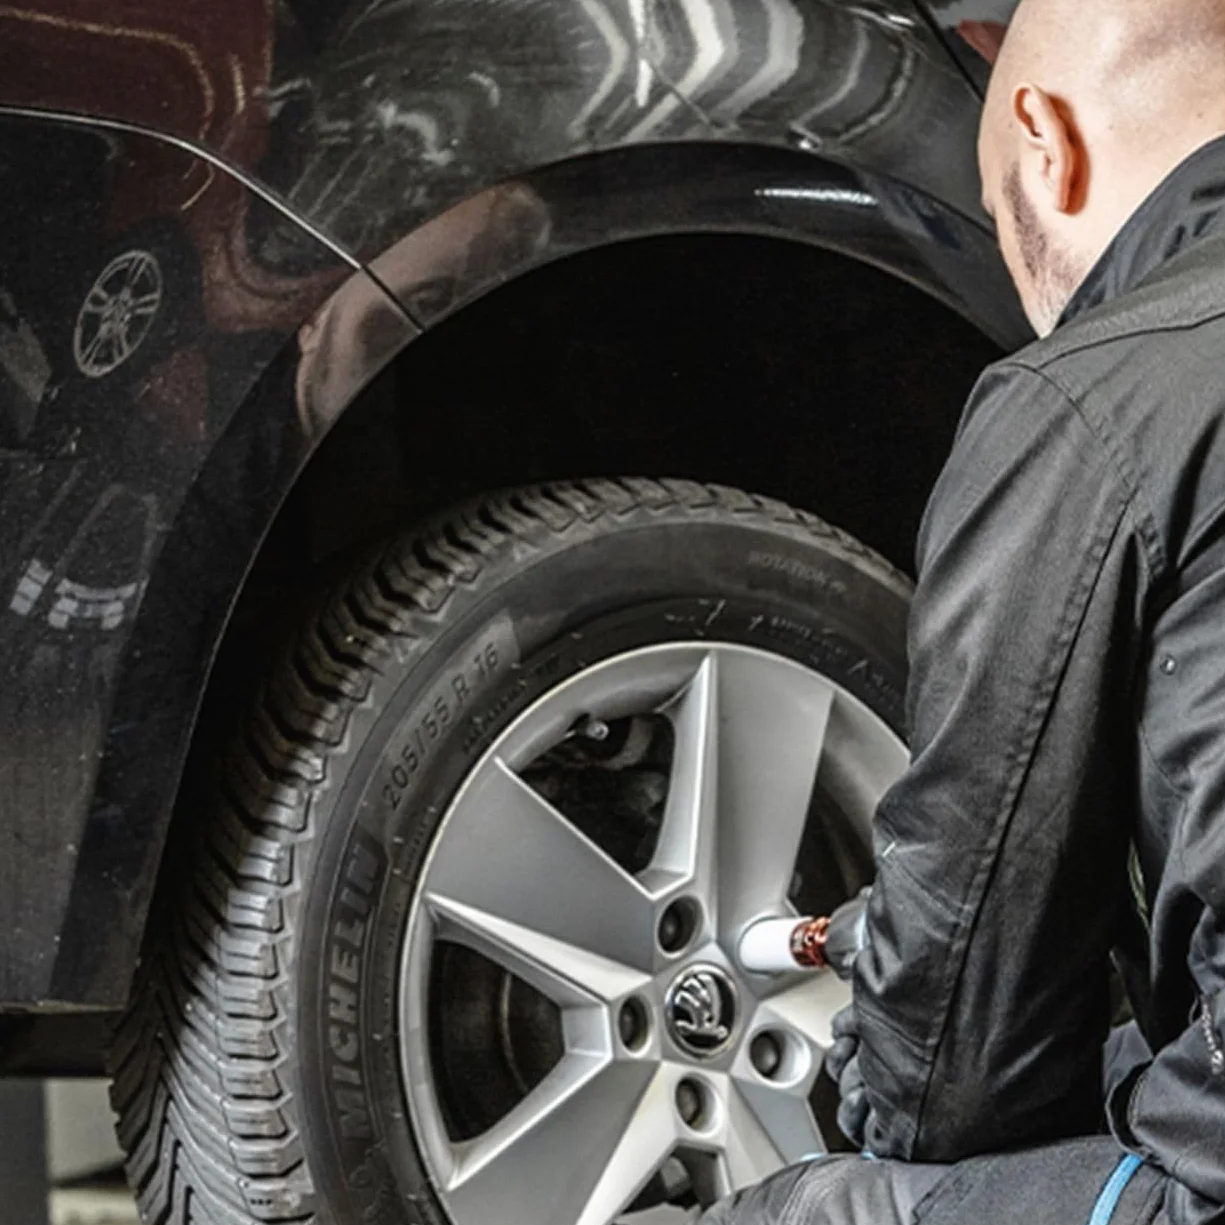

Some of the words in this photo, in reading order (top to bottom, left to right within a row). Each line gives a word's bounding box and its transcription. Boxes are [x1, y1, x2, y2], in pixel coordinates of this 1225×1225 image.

[382, 696, 451, 811] 205/55
[451, 673, 471, 702] R
[473, 642, 500, 678] 16
[327, 840, 381, 1140] MICHELIN
